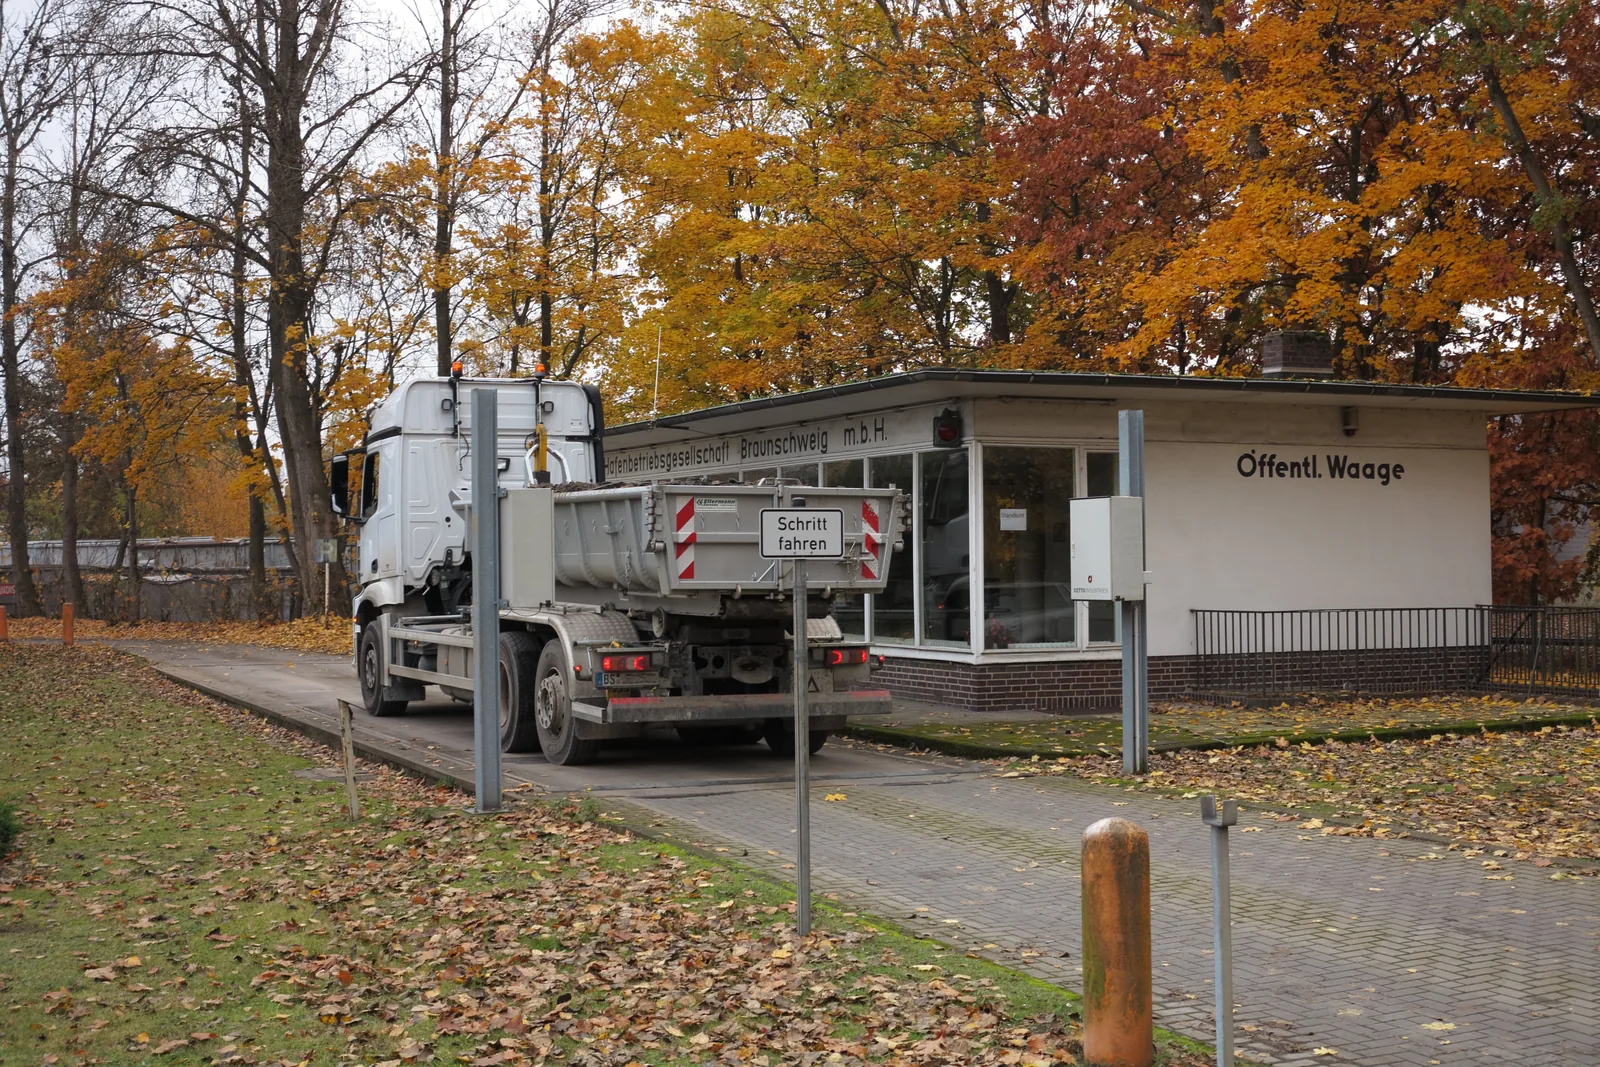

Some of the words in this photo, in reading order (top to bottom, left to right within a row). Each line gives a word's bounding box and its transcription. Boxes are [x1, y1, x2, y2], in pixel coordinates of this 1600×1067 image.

[741, 427, 828, 459] Braunschweig
[1326, 455, 1405, 486] Waage
[777, 516, 827, 531] Schritt
[778, 536, 827, 550] fahren
[603, 673, 616, 685] BS
